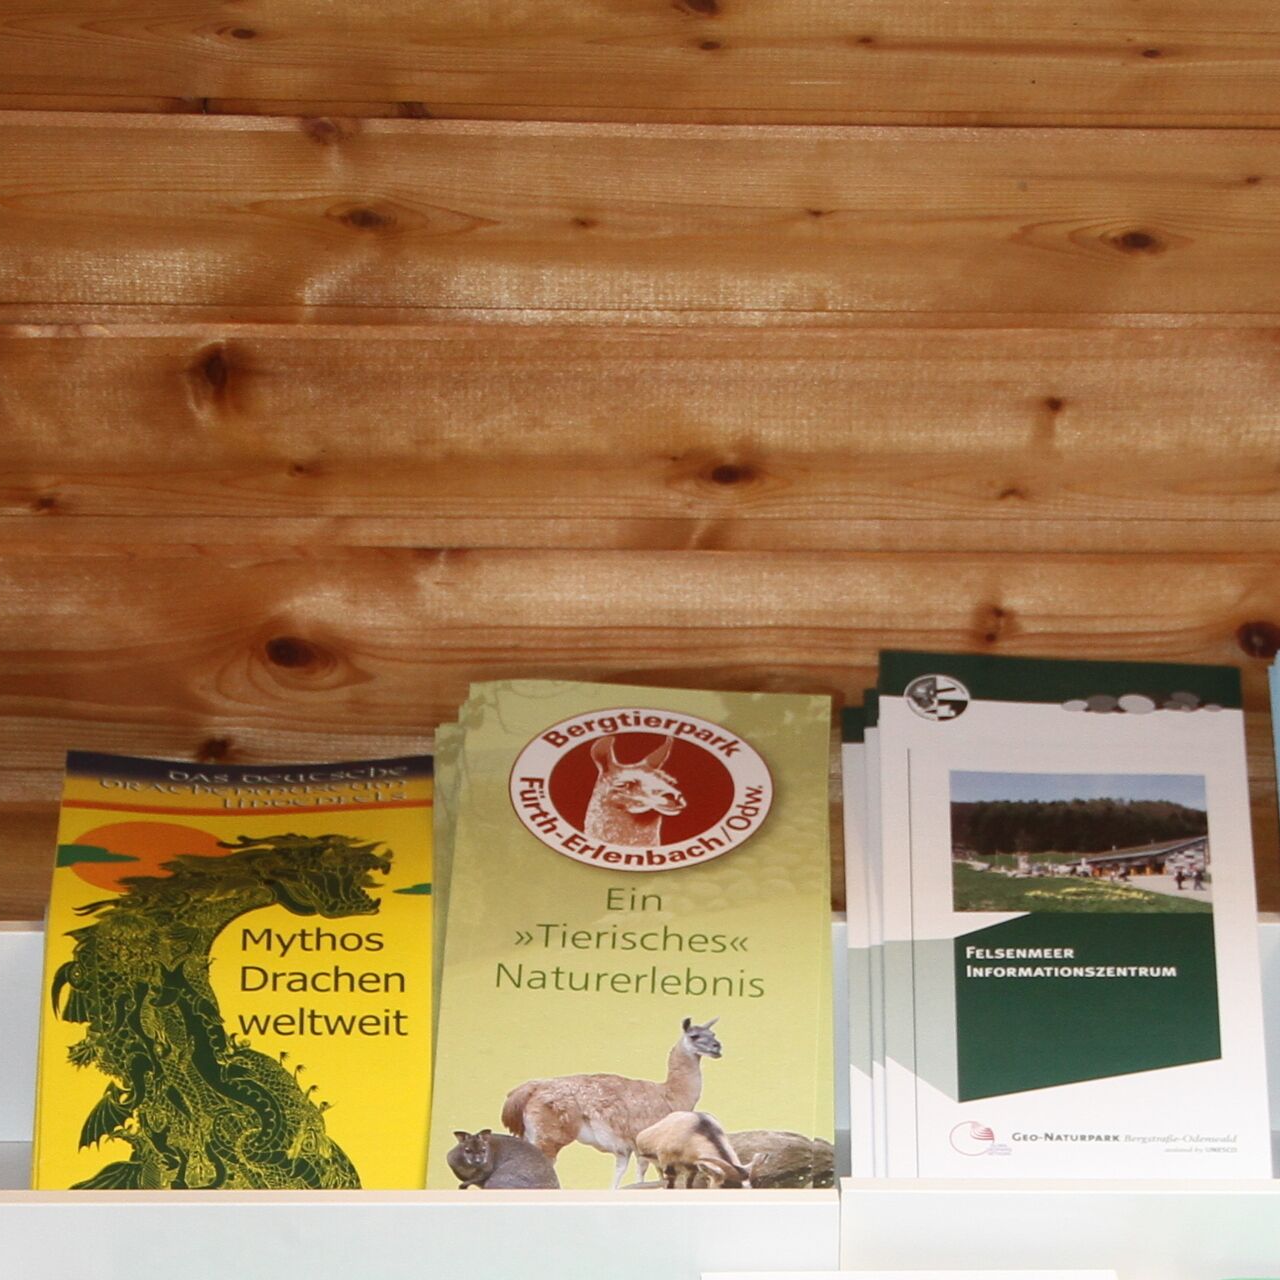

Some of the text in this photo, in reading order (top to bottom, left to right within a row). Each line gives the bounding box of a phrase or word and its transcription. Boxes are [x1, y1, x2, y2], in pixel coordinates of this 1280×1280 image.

[542, 711, 742, 757] Bergtierpark
[606, 888, 663, 911] Ein
[242, 928, 384, 957] Mythos
[241, 966, 406, 993] Drachen
[495, 963, 765, 998] Naturerlebnis
[238, 1008, 409, 1036] weltweit
